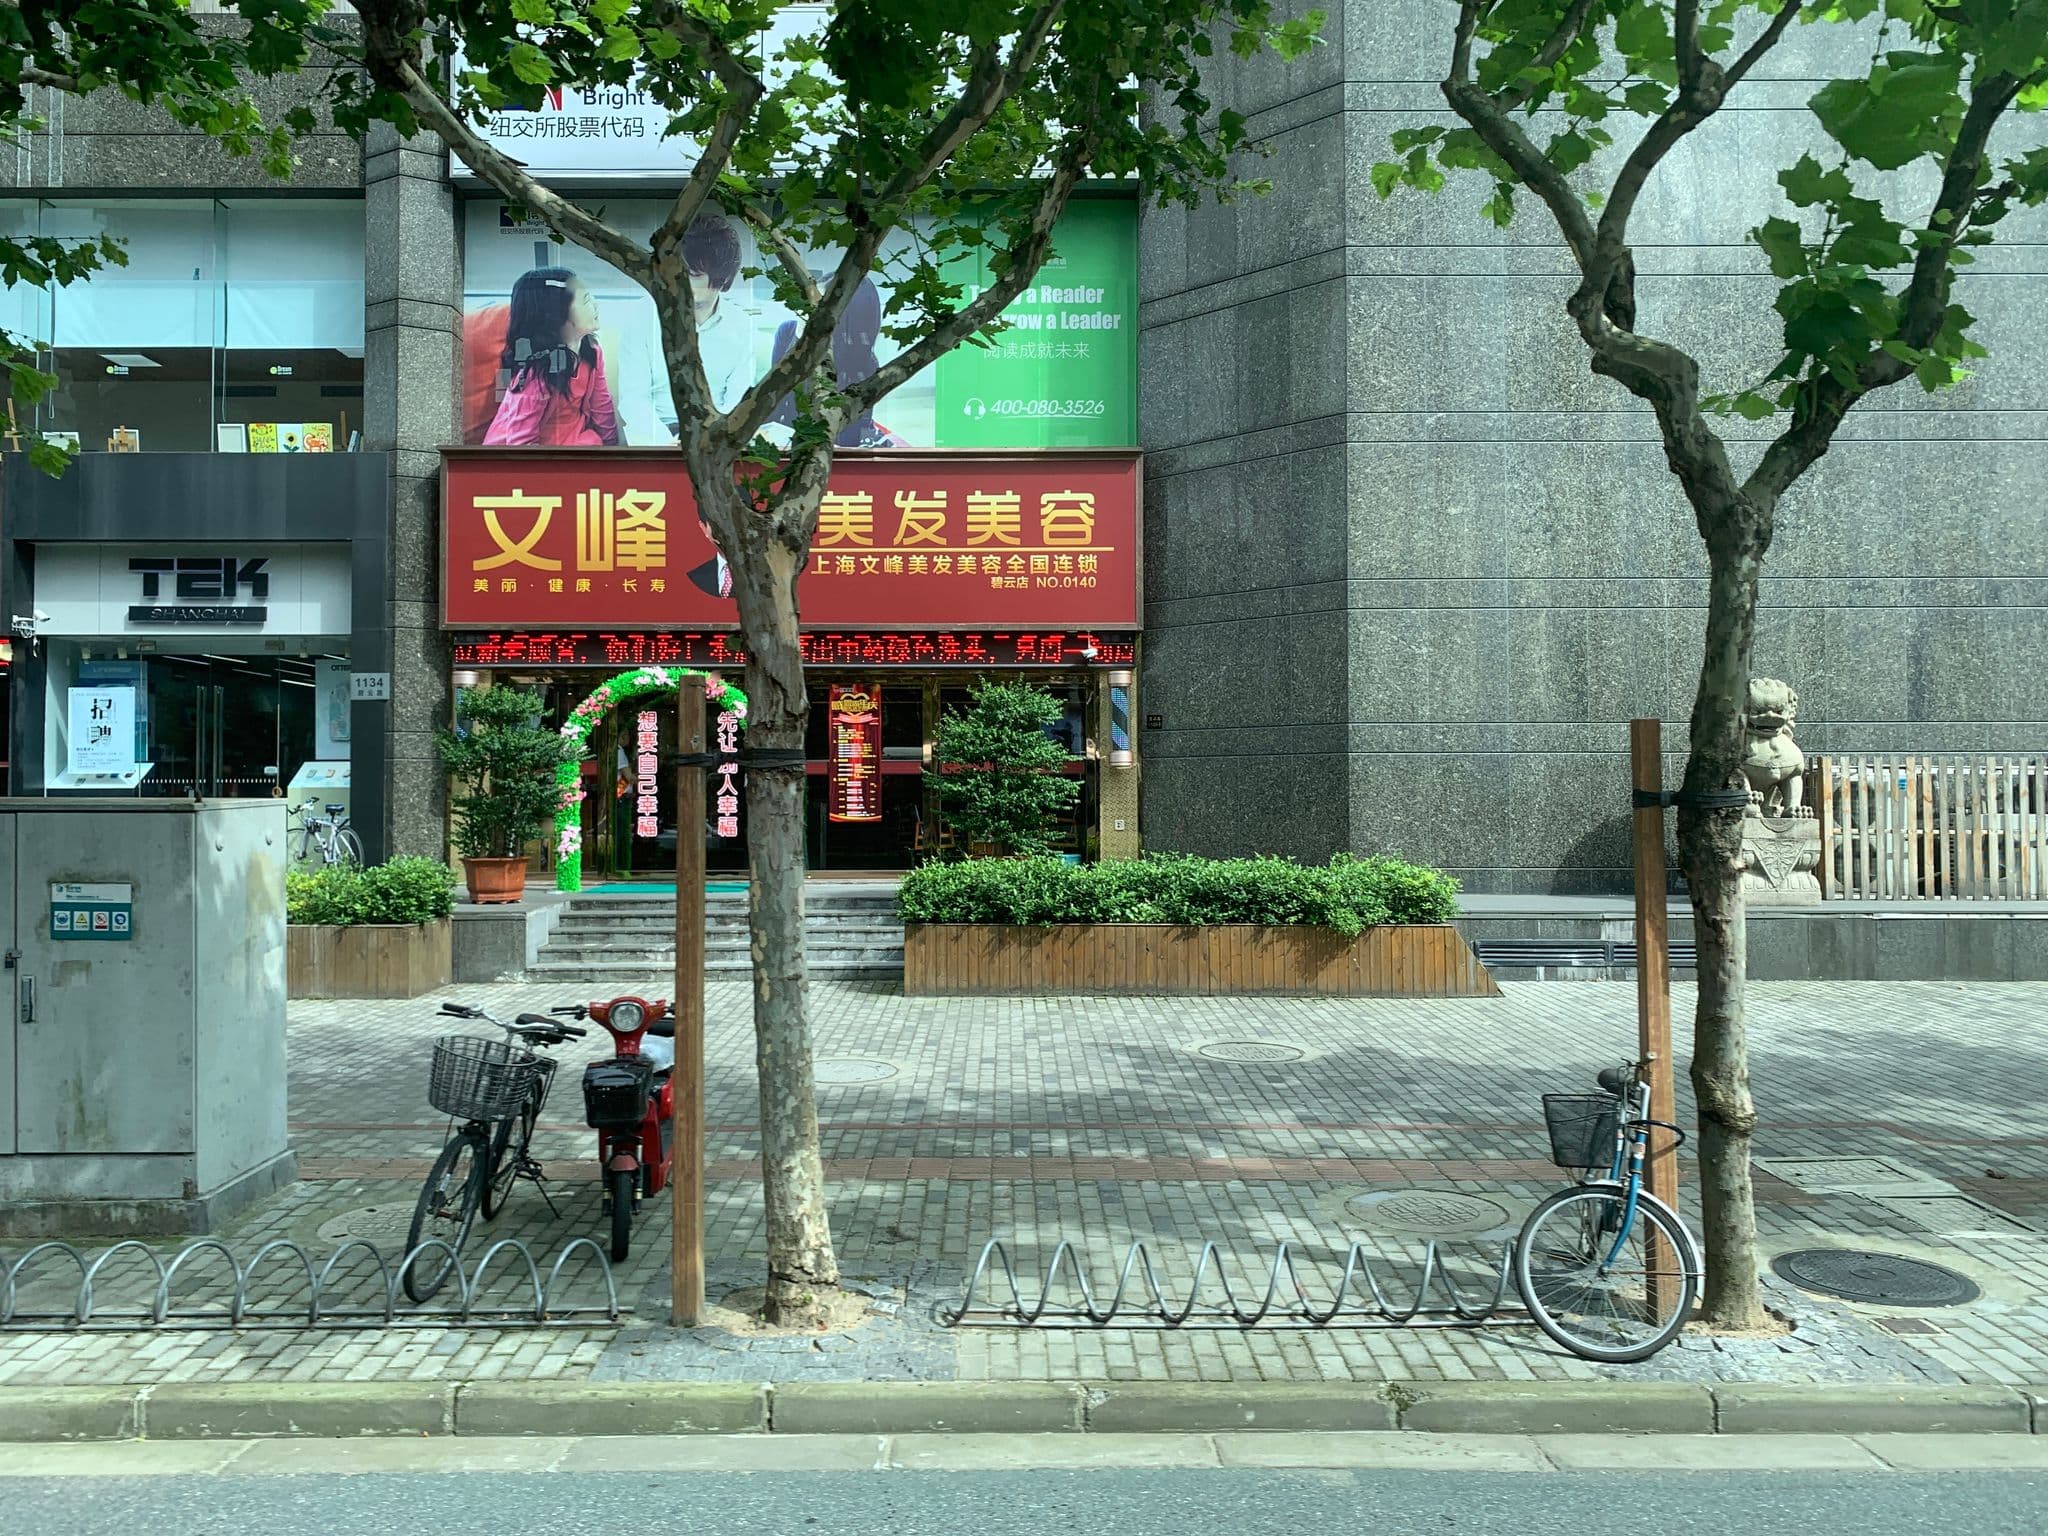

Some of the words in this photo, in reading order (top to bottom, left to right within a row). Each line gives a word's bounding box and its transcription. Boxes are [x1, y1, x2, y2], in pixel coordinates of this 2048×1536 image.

[584, 88, 646, 110] Bright
[1040, 285, 1105, 304] Reader
[1046, 315, 1056, 330] a
[1061, 311, 1121, 330] Leader
[990, 399, 1105, 415] 400-080-3526
[818, 489, 1095, 546] 美发美容
[472, 488, 667, 572] 文峰
[810, 554, 1098, 575] 上海文峰美发美容全国连锁
[990, 576, 1029, 590] 碧云店
[1036, 576, 1097, 589] NO.0140
[355, 677, 384, 688] 1134
[637, 710, 658, 838] 想要自己幸福
